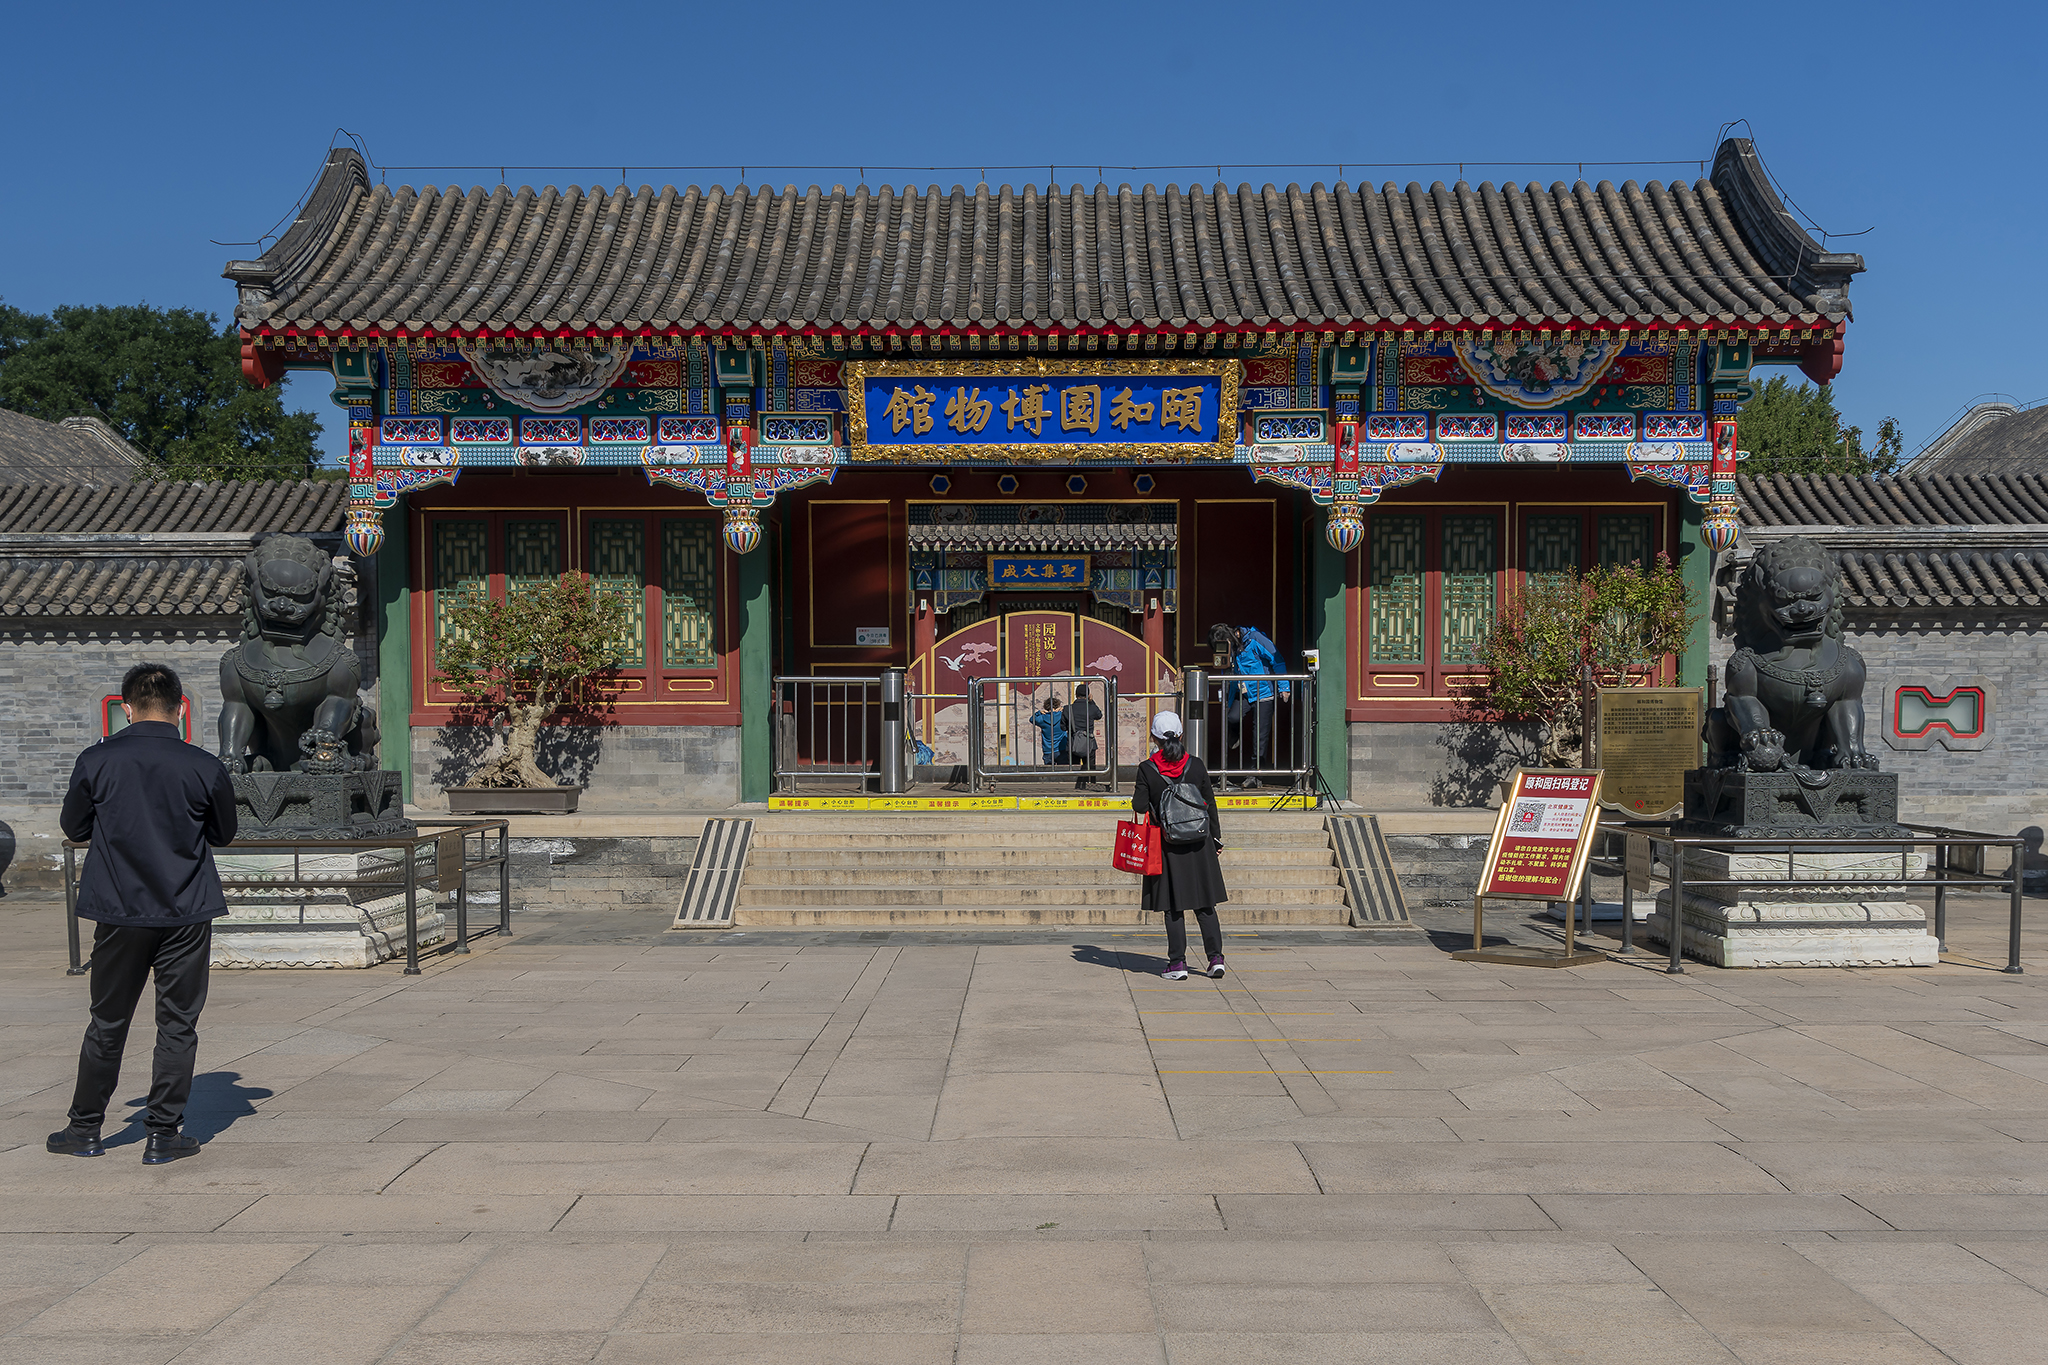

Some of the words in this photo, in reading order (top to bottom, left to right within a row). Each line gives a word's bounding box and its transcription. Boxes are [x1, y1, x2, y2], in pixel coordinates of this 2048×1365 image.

[1001, 563, 1077, 579] 聖集大成
[1043, 623, 1056, 650] 园说
[1524, 777, 1589, 791] 颐和园扫码登记
